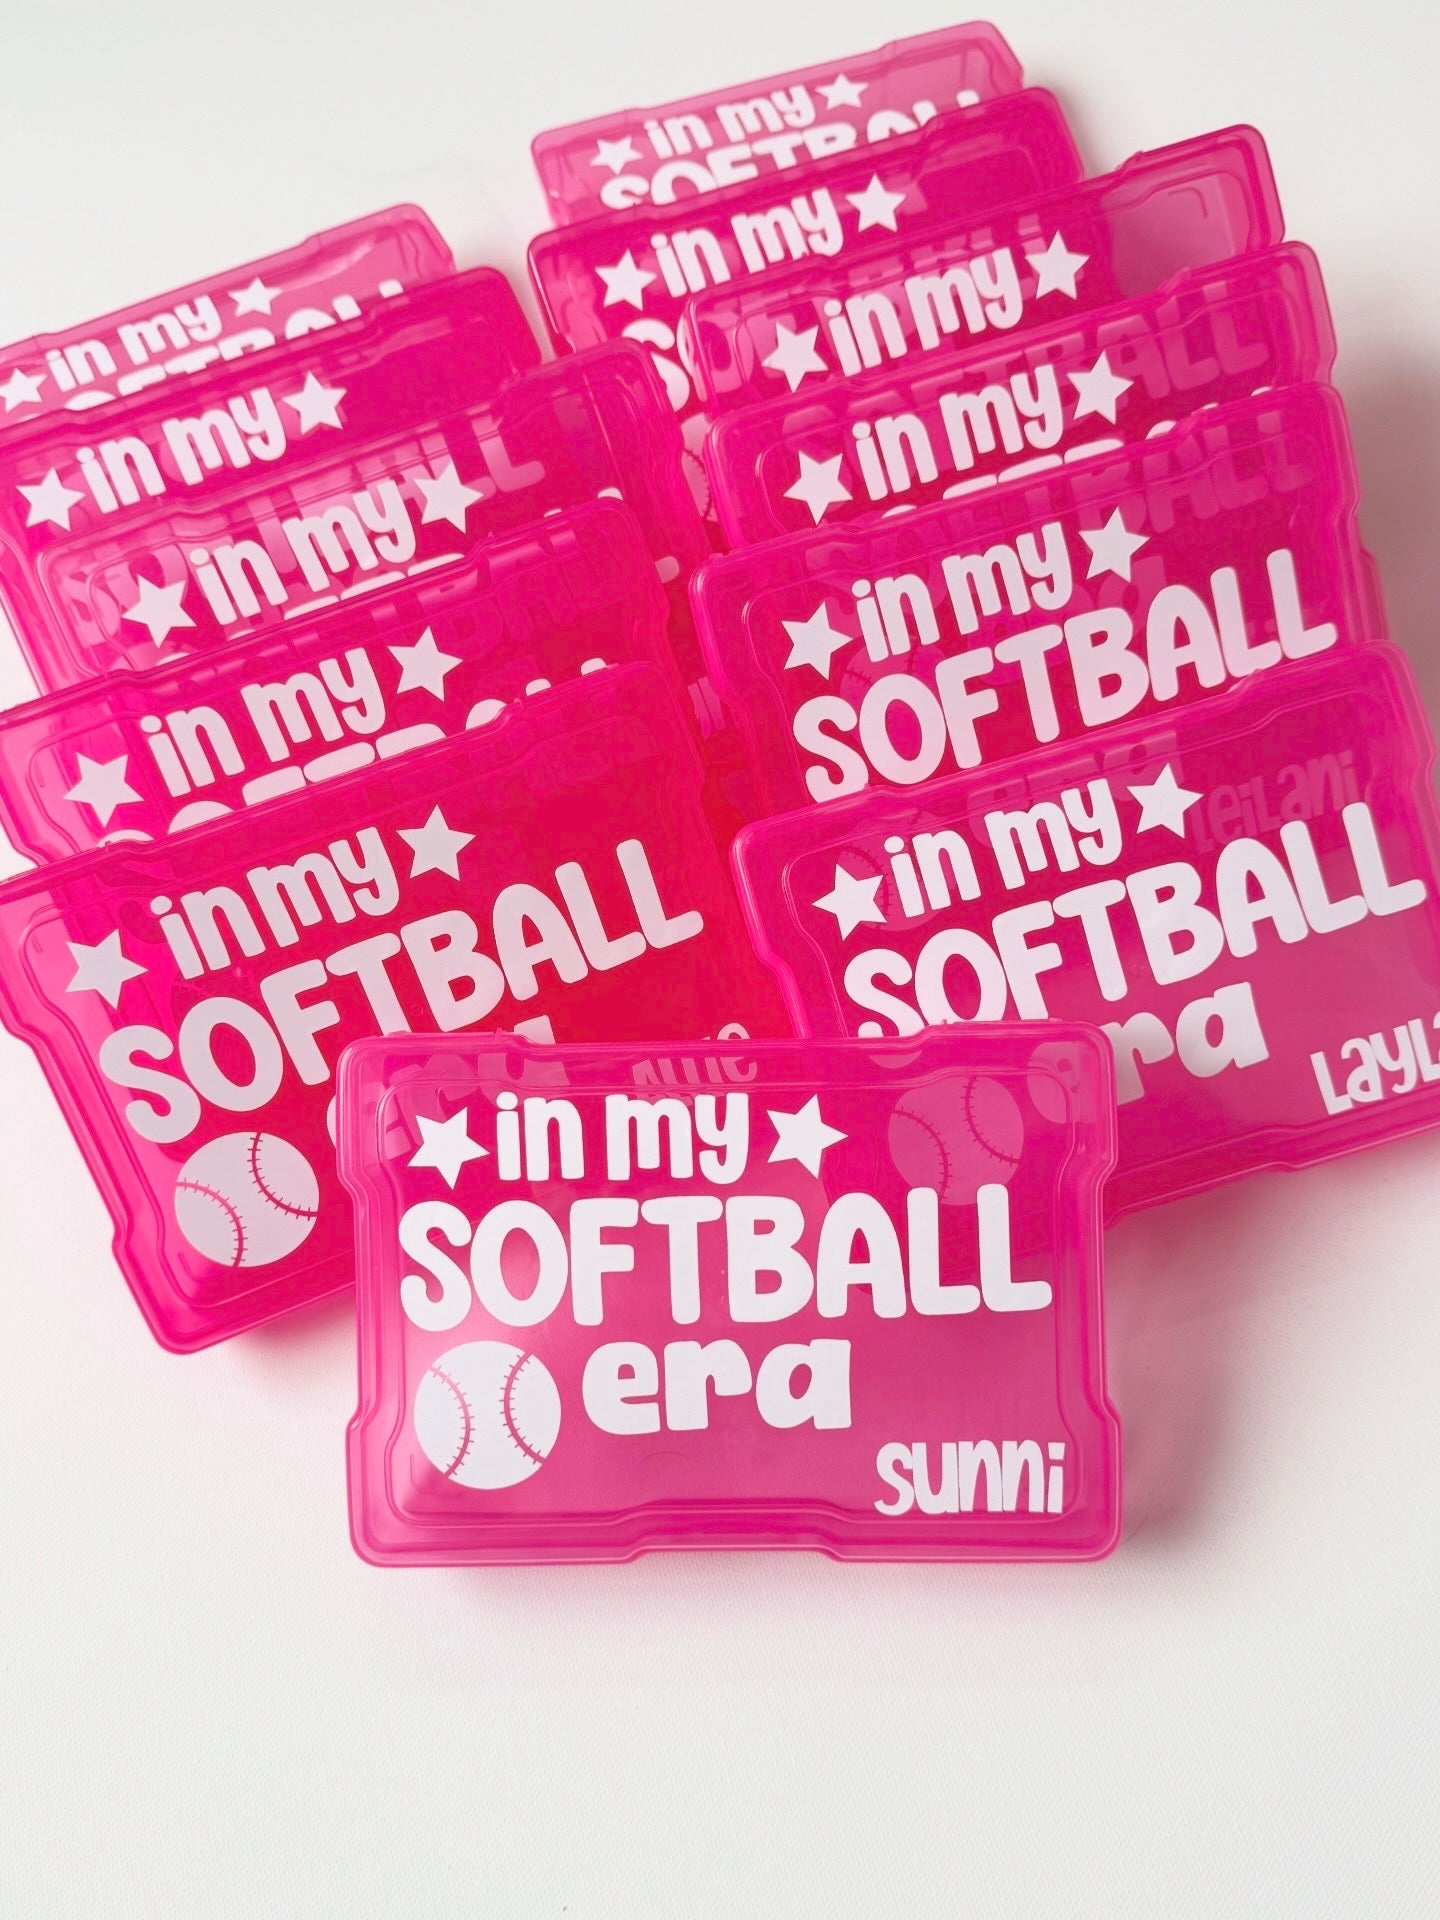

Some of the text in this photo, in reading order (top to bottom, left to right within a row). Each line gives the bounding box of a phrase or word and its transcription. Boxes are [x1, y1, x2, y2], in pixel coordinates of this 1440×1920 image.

[644, 85, 816, 159] in my
[651, 189, 843, 296] in my
[46, 340, 117, 392] in
[117, 295, 222, 365] my
[823, 293, 907, 375] in
[904, 248, 1023, 349] my
[76, 388, 286, 513] in my
[850, 365, 1063, 500] in my
[189, 540, 288, 625] in
[282, 480, 416, 592] my
[850, 574, 941, 662] in
[941, 522, 1072, 635] my
[140, 706, 246, 797] in
[241, 647, 386, 762] my
[793, 549, 1338, 803] SOFTBALL
[151, 827, 400, 979] in my
[884, 778, 1122, 918] in my
[99, 838, 705, 1143] SOFTBALL
[843, 802, 1427, 1067] SOFTBALL
[496, 1091, 749, 1185] in my
[399, 1183, 1053, 1333] SOFTBALL
[582, 1338, 852, 1435] era
[874, 1439, 1065, 1516] sunni
